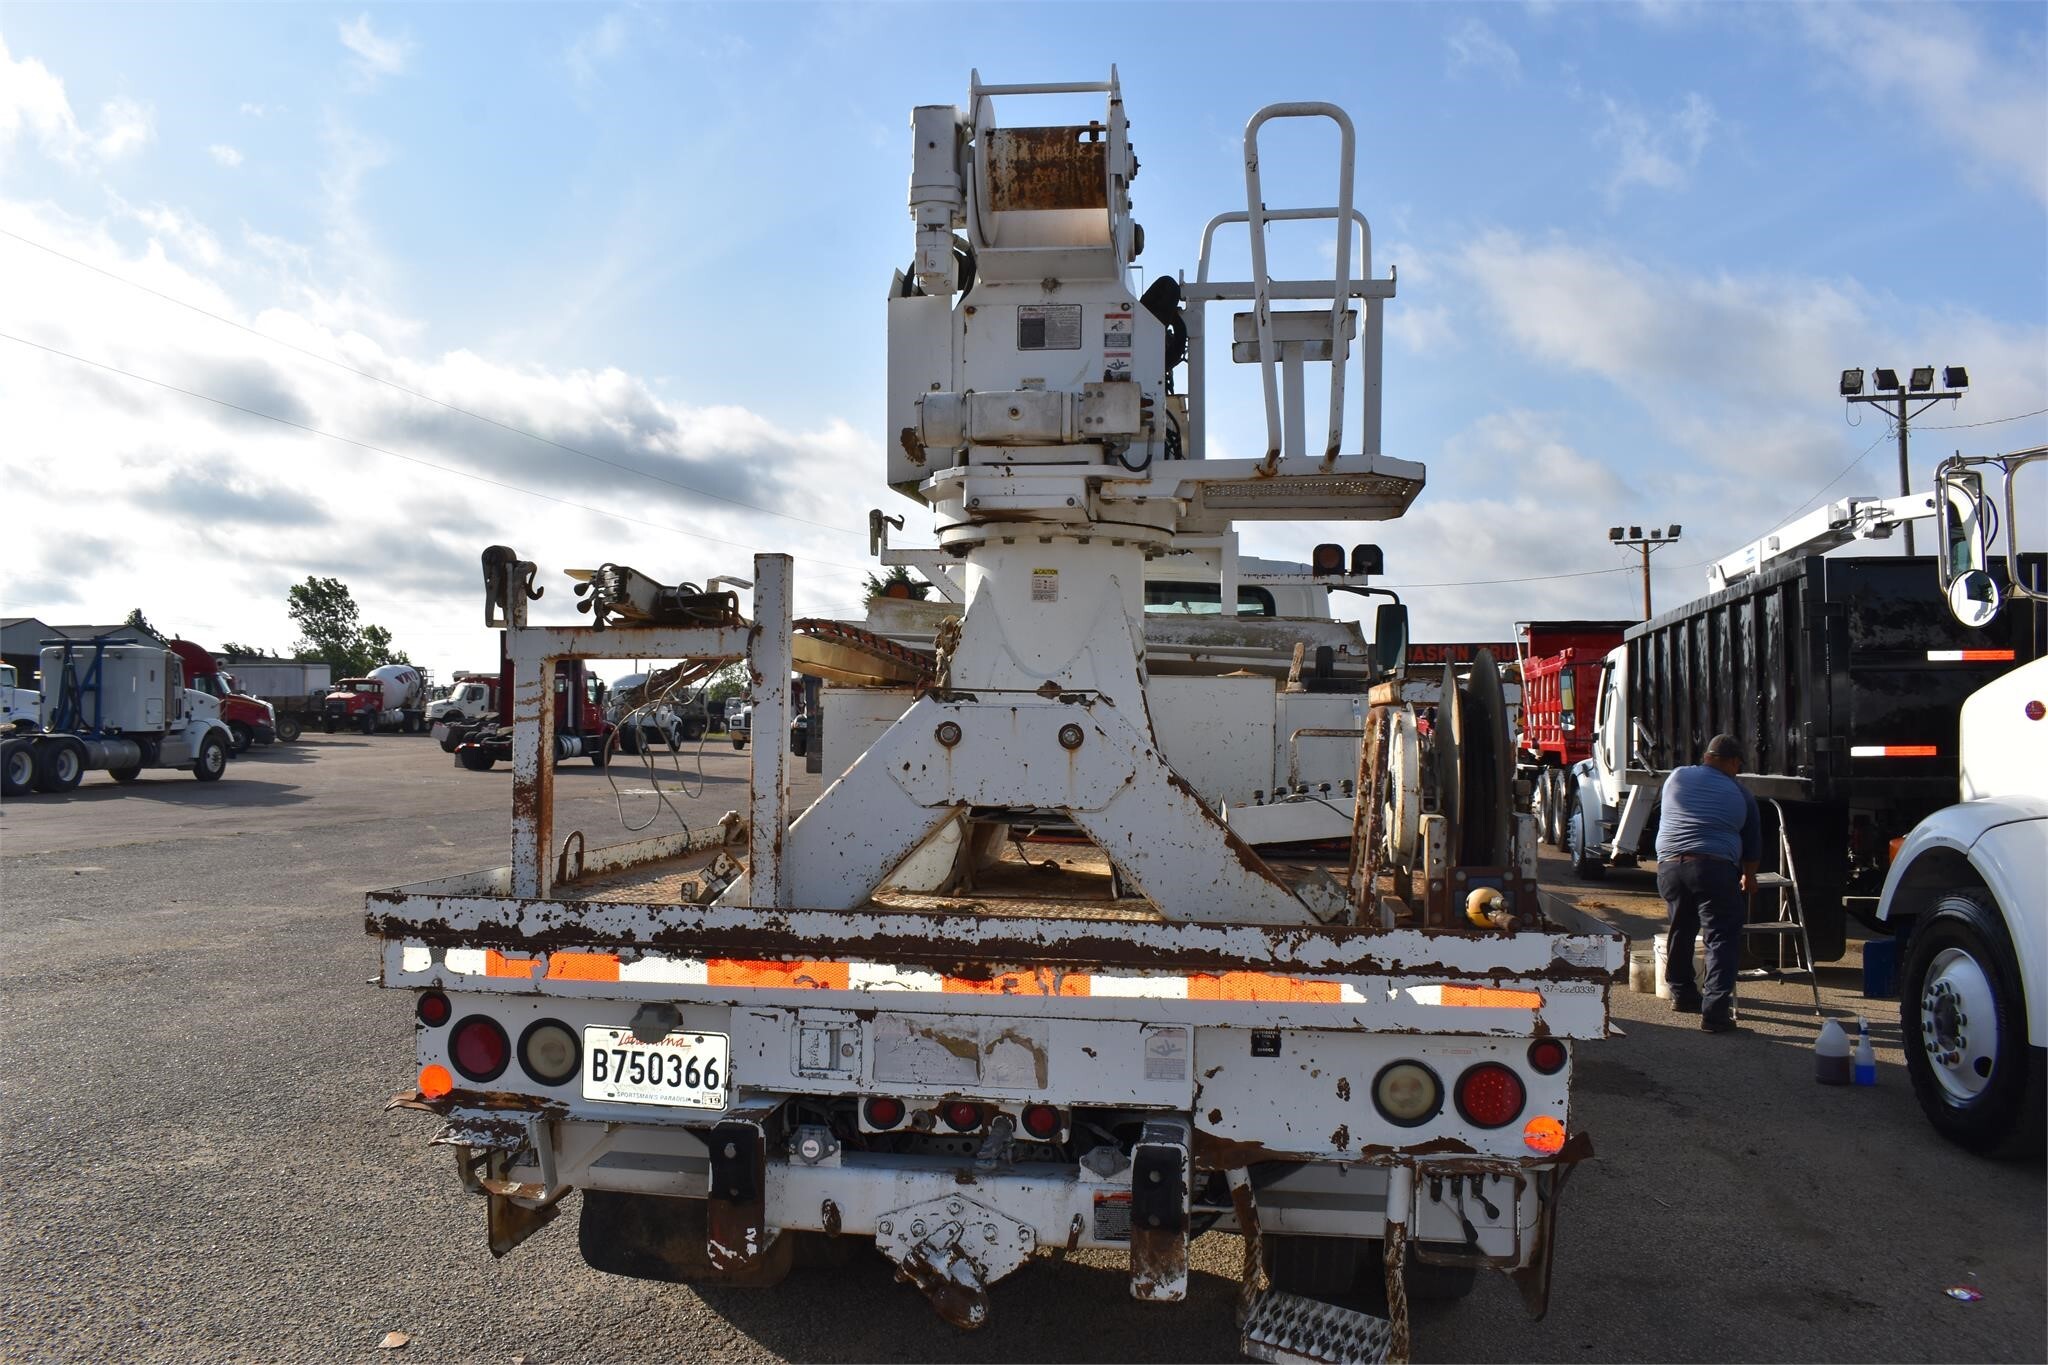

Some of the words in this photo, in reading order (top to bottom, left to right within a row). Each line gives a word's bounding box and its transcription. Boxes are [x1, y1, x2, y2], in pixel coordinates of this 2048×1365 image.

[618, 1031, 692, 1048] Louna
[592, 1048, 719, 1090] B750366
[617, 1091, 658, 1100] SPORTSMAN'S
[709, 1096, 720, 1104] 19
